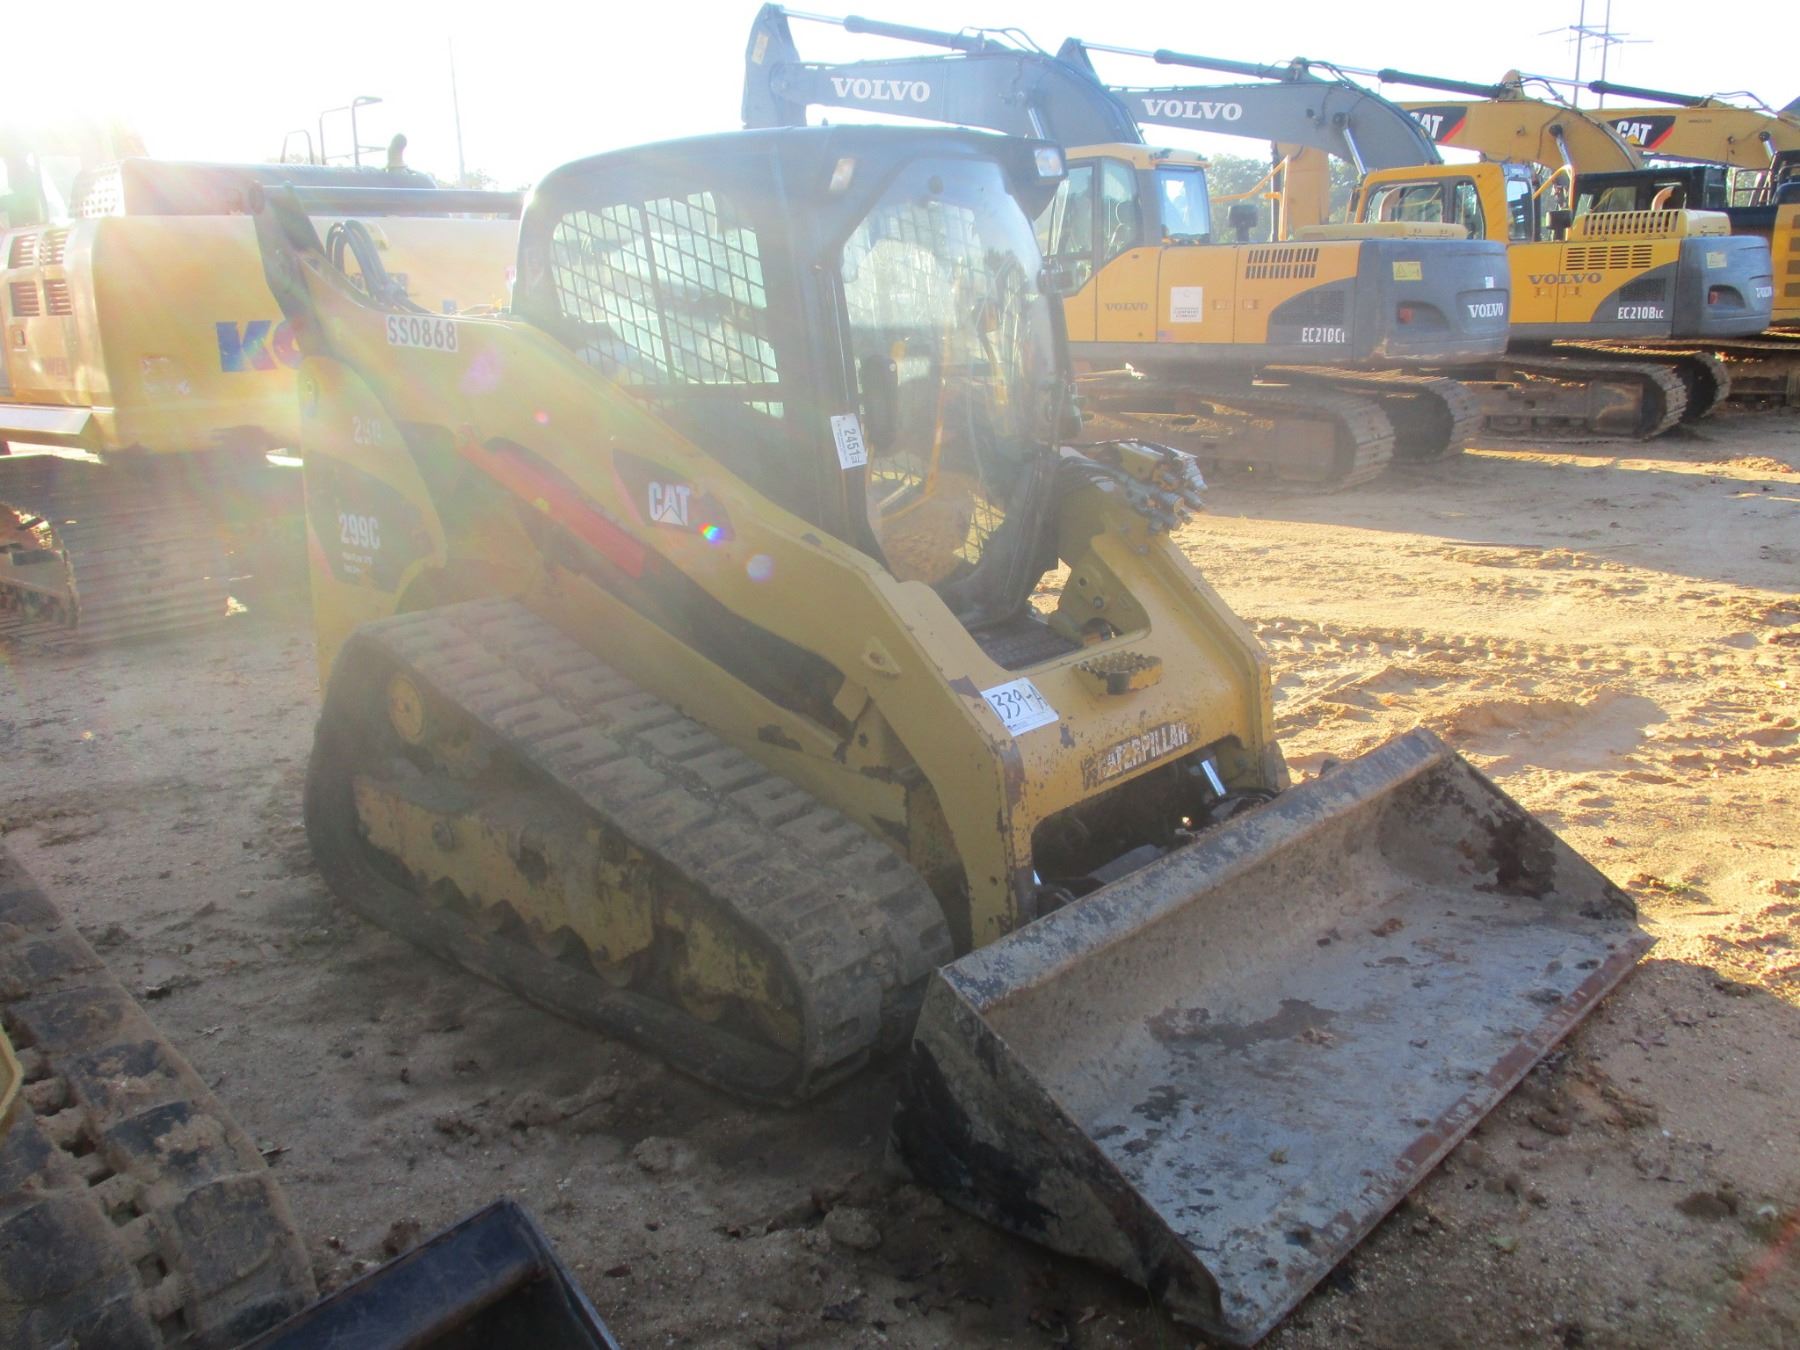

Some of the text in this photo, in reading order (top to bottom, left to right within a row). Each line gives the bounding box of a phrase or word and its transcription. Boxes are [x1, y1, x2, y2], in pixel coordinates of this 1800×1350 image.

[830, 77, 931, 102] VOLVO
[1141, 98, 1242, 121] VOLVO
[1616, 121, 1652, 145] CAT
[1528, 272, 1602, 285] VOLVO
[1467, 302, 1504, 319] VOLVO
[387, 316, 457, 351] SS0868
[648, 482, 690, 527] CAT
[339, 513, 380, 550] 299C
